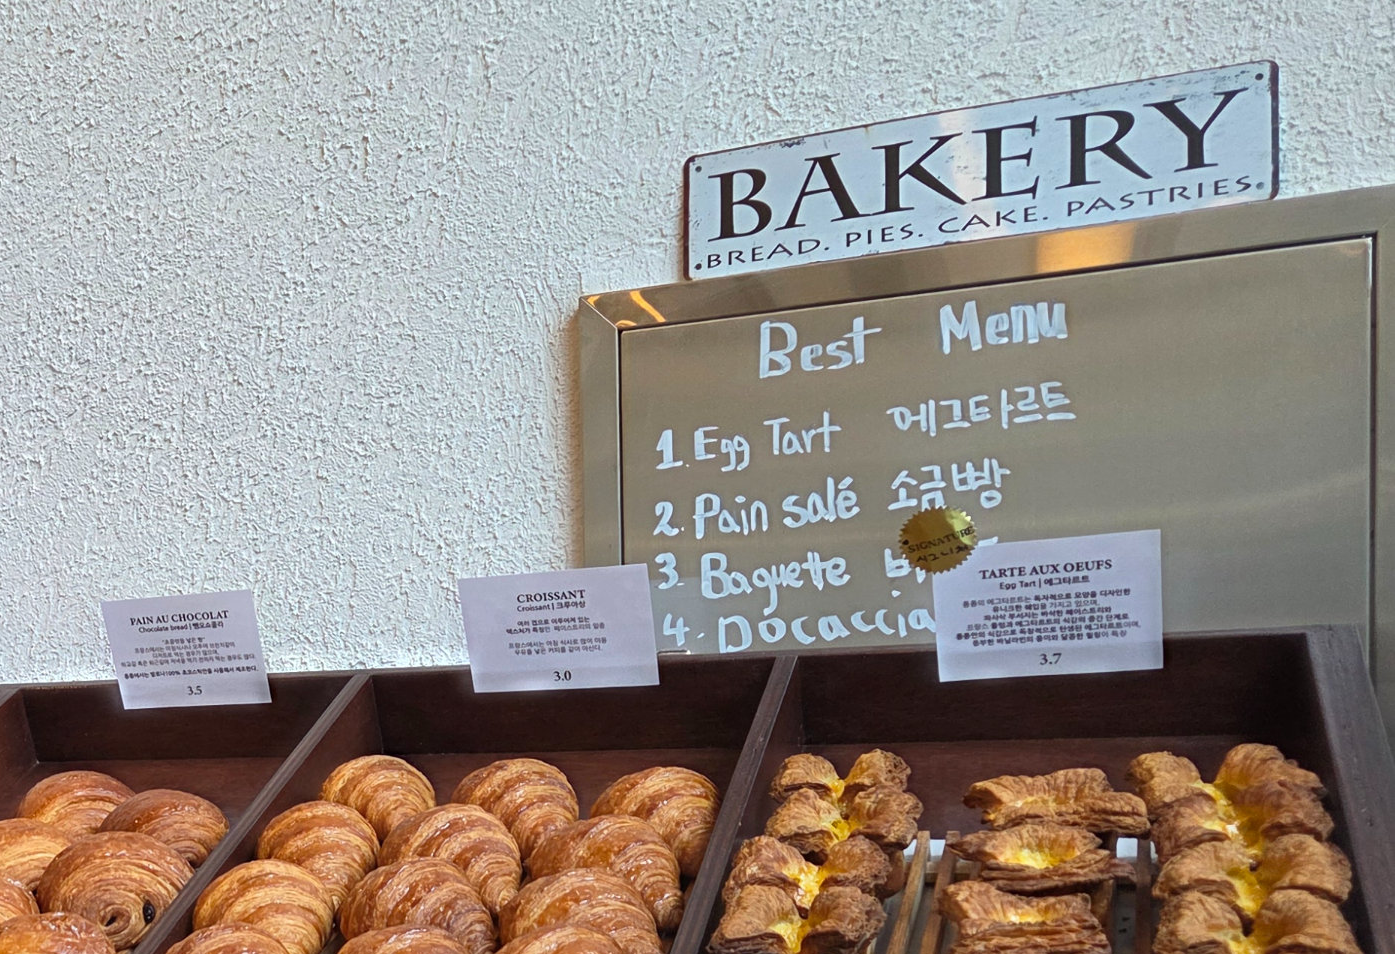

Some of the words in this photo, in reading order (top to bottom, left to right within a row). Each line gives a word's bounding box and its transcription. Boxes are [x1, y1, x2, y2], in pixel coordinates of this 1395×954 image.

[707, 87, 1250, 243] BAKERY
[707, 238, 830, 270] BREAD.
[846, 225, 924, 249] PIES.
[938, 206, 1049, 234] CAKE.
[759, 316, 883, 380] Best
[939, 300, 1069, 355] Menu
[694, 426, 750, 472] Egg
[763, 411, 842, 455] Tart
[887, 382, 1076, 436] 에그타르트
[693, 493, 768, 539] Pain
[782, 476, 860, 528] salé
[887, 458, 1011, 509] 소금빵
[907, 526, 974, 553] SIGNATURE
[978, 566, 1027, 580] TARTE
[1028, 563, 1061, 576] AUX
[1062, 558, 1113, 573] OEUFS
[701, 552, 851, 616] Baguette
[999, 581, 1016, 590] Egg
[1018, 580, 1036, 588] Tart
[1043, 574, 1090, 586] 에그타르트
[516, 589, 586, 604] CROISSANT
[516, 603, 550, 613] Croissant
[556, 600, 586, 610] 크루아상
[129, 615, 154, 626] PAIN
[155, 614, 169, 624] AU
[170, 609, 229, 623] CHOCOLAT
[138, 625, 169, 634] Chocolate
[169, 623, 188, 631] bread
[1039, 652, 1062, 666] 3.7
[553, 670, 572, 682] 3.0
[186, 685, 203, 696] 3.5
